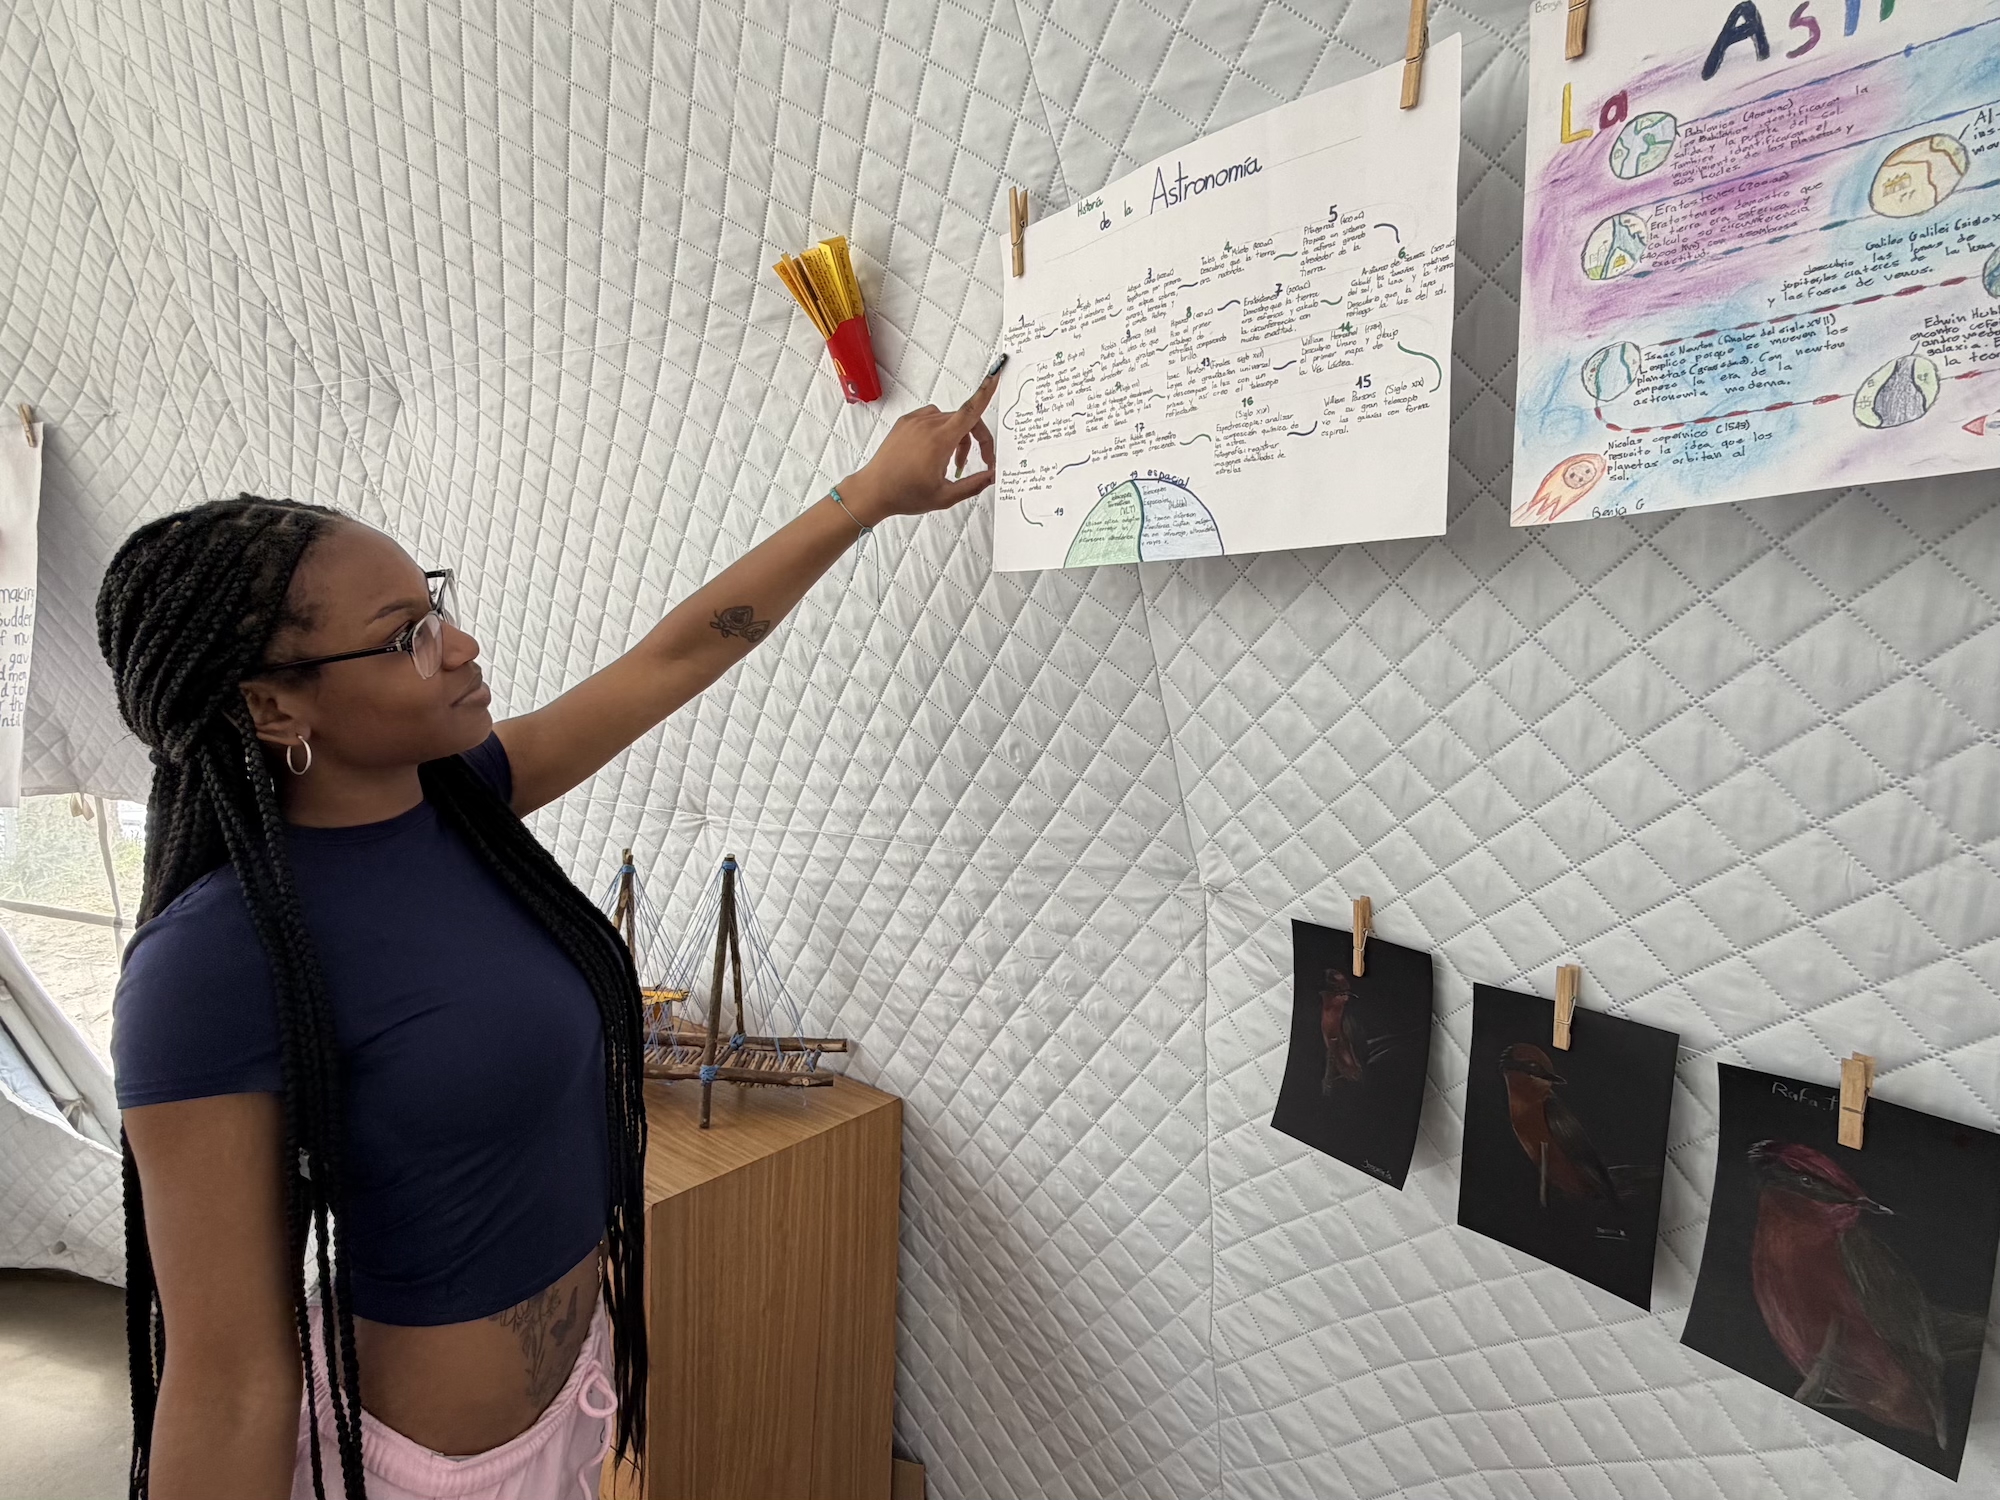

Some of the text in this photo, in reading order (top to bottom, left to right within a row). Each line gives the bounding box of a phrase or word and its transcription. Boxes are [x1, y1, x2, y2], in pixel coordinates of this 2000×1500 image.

[1790, 117, 1808, 129] del
[1150, 156, 1262, 215] Astronomía
[1328, 205, 1338, 222] 5
[1957, 233, 1977, 243] de
[1398, 246, 1406, 259] 6
[1855, 277, 1874, 288] de
[1925, 314, 1966, 328] Edwin
[1760, 326, 1775, 337] del
[1826, 325, 1848, 336] los
[1944, 356, 1961, 366] la
[1693, 375, 1705, 385] la
[1751, 368, 1766, 377] de
[1778, 362, 1792, 371] la
[1355, 374, 1371, 389] 15
[1241, 396, 1253, 407] 16
[1608, 436, 1642, 450] Nicolas
[1660, 445, 1671, 454] la
[1685, 441, 1714, 450] idea
[1754, 431, 1773, 442] los
[1607, 446, 1745, 474] planetas orbitan al
